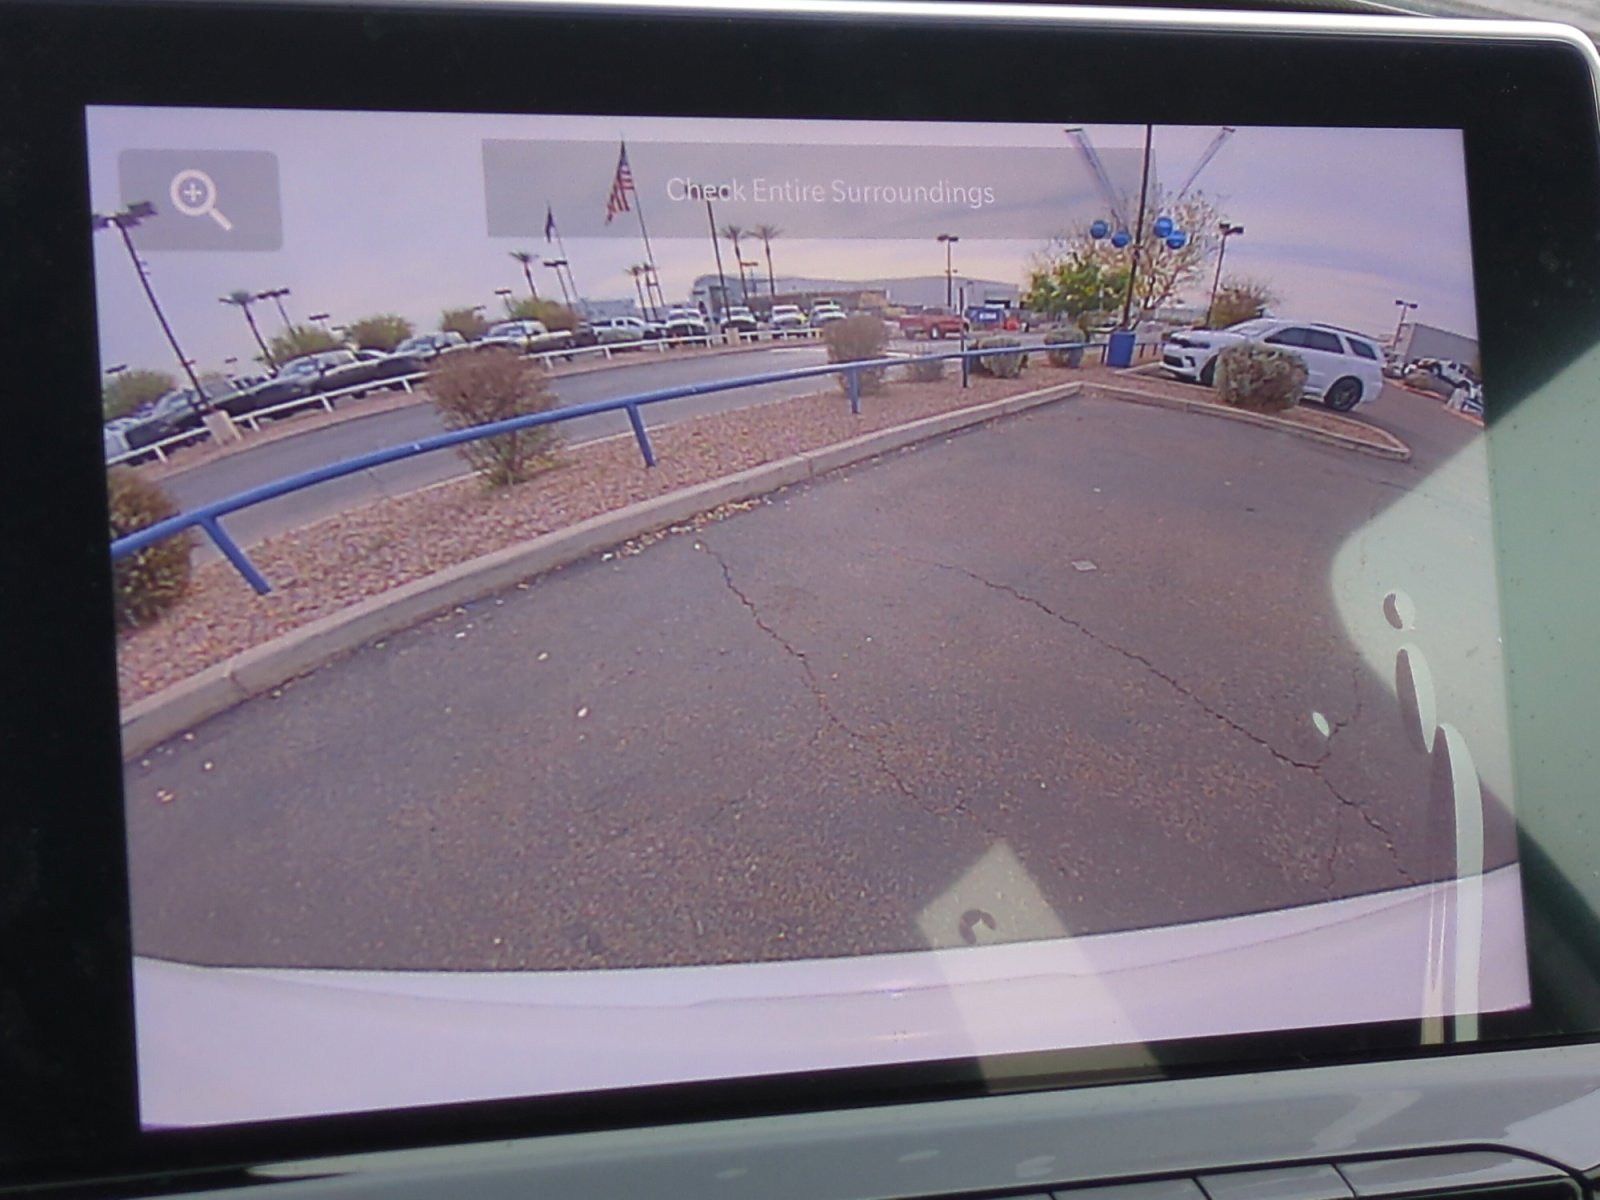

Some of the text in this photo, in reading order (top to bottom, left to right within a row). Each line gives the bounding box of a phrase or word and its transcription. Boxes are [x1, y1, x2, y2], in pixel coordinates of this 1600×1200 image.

[666, 177, 995, 208] Check Entire Surroundings
